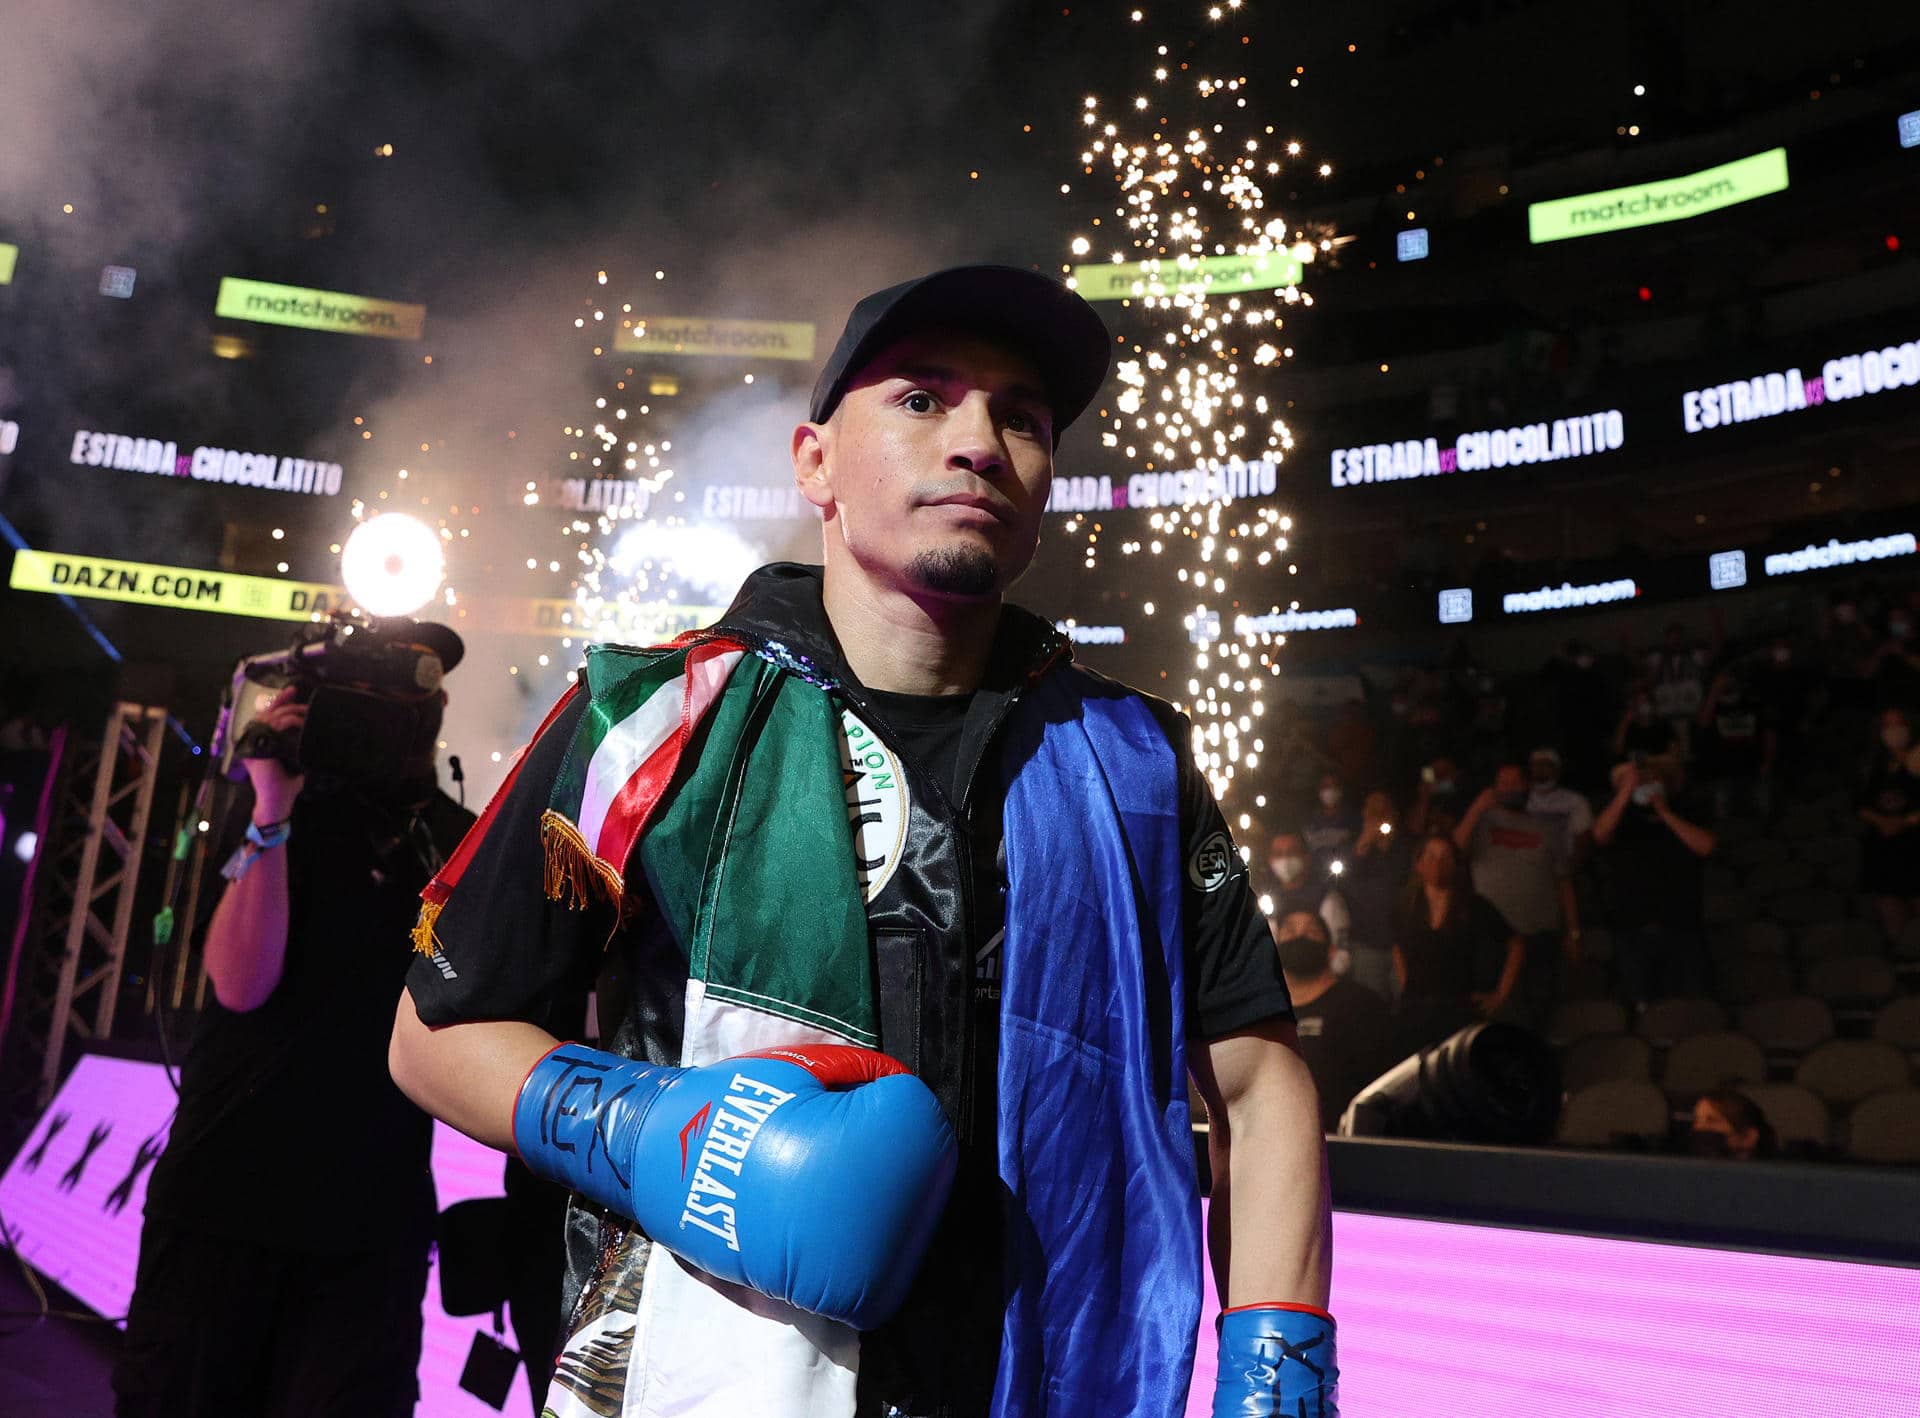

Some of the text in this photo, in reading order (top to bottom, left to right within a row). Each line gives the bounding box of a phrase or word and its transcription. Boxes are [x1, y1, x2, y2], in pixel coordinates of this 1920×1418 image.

[1683, 368, 1807, 433] ESTRADA
[1823, 339, 1920, 401] CHOCO
[70, 430, 177, 476] ESTRADA
[190, 446, 343, 496] CHOCOLATITO
[1331, 437, 1440, 487] ESTRADA
[1456, 409, 1624, 472] CHOCOLATITO
[51, 562, 223, 602] DAZN.COM
[848, 725, 894, 790] PION
[681, 1073, 797, 1252] EVERLAST
